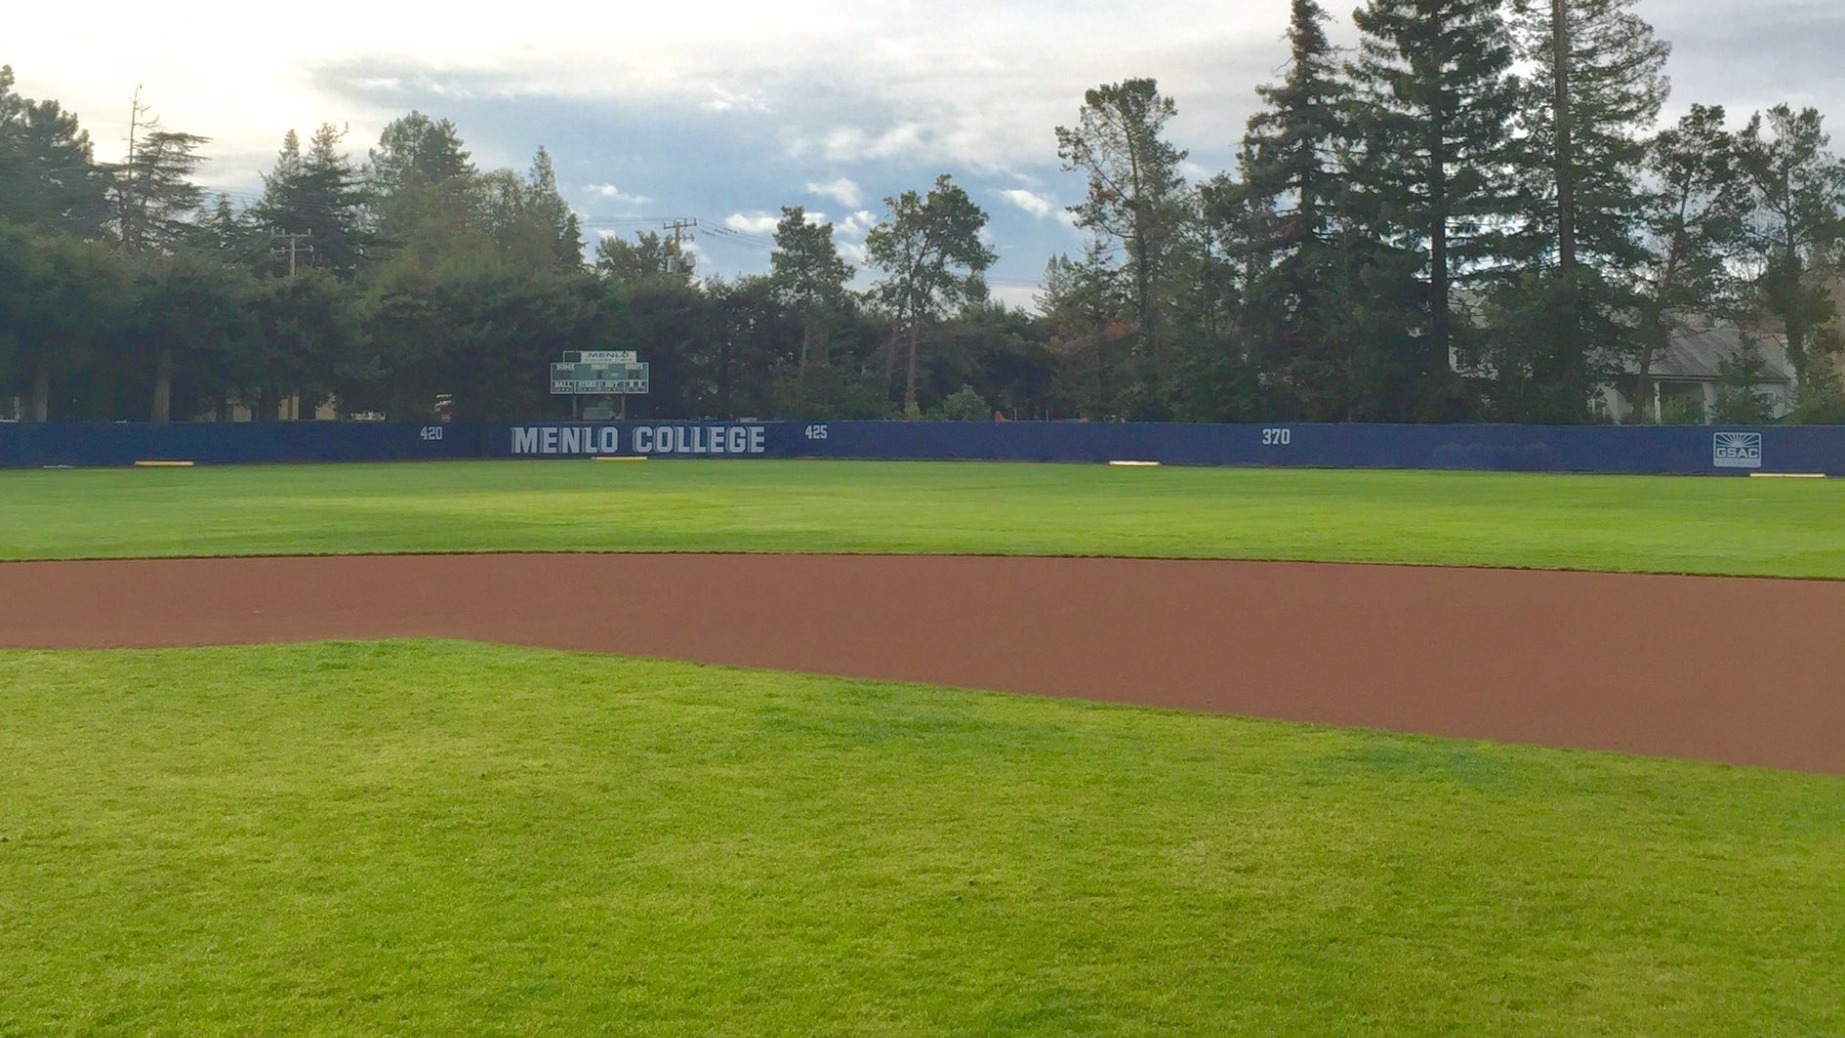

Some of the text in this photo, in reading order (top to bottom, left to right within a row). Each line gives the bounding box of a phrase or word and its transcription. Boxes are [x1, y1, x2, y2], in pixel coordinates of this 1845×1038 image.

[420, 426, 443, 440] 420
[511, 425, 766, 454] MENLO COLLEGE
[805, 424, 828, 440] 425
[1262, 428, 1291, 445] 370
[1716, 447, 1759, 459] GSAC
